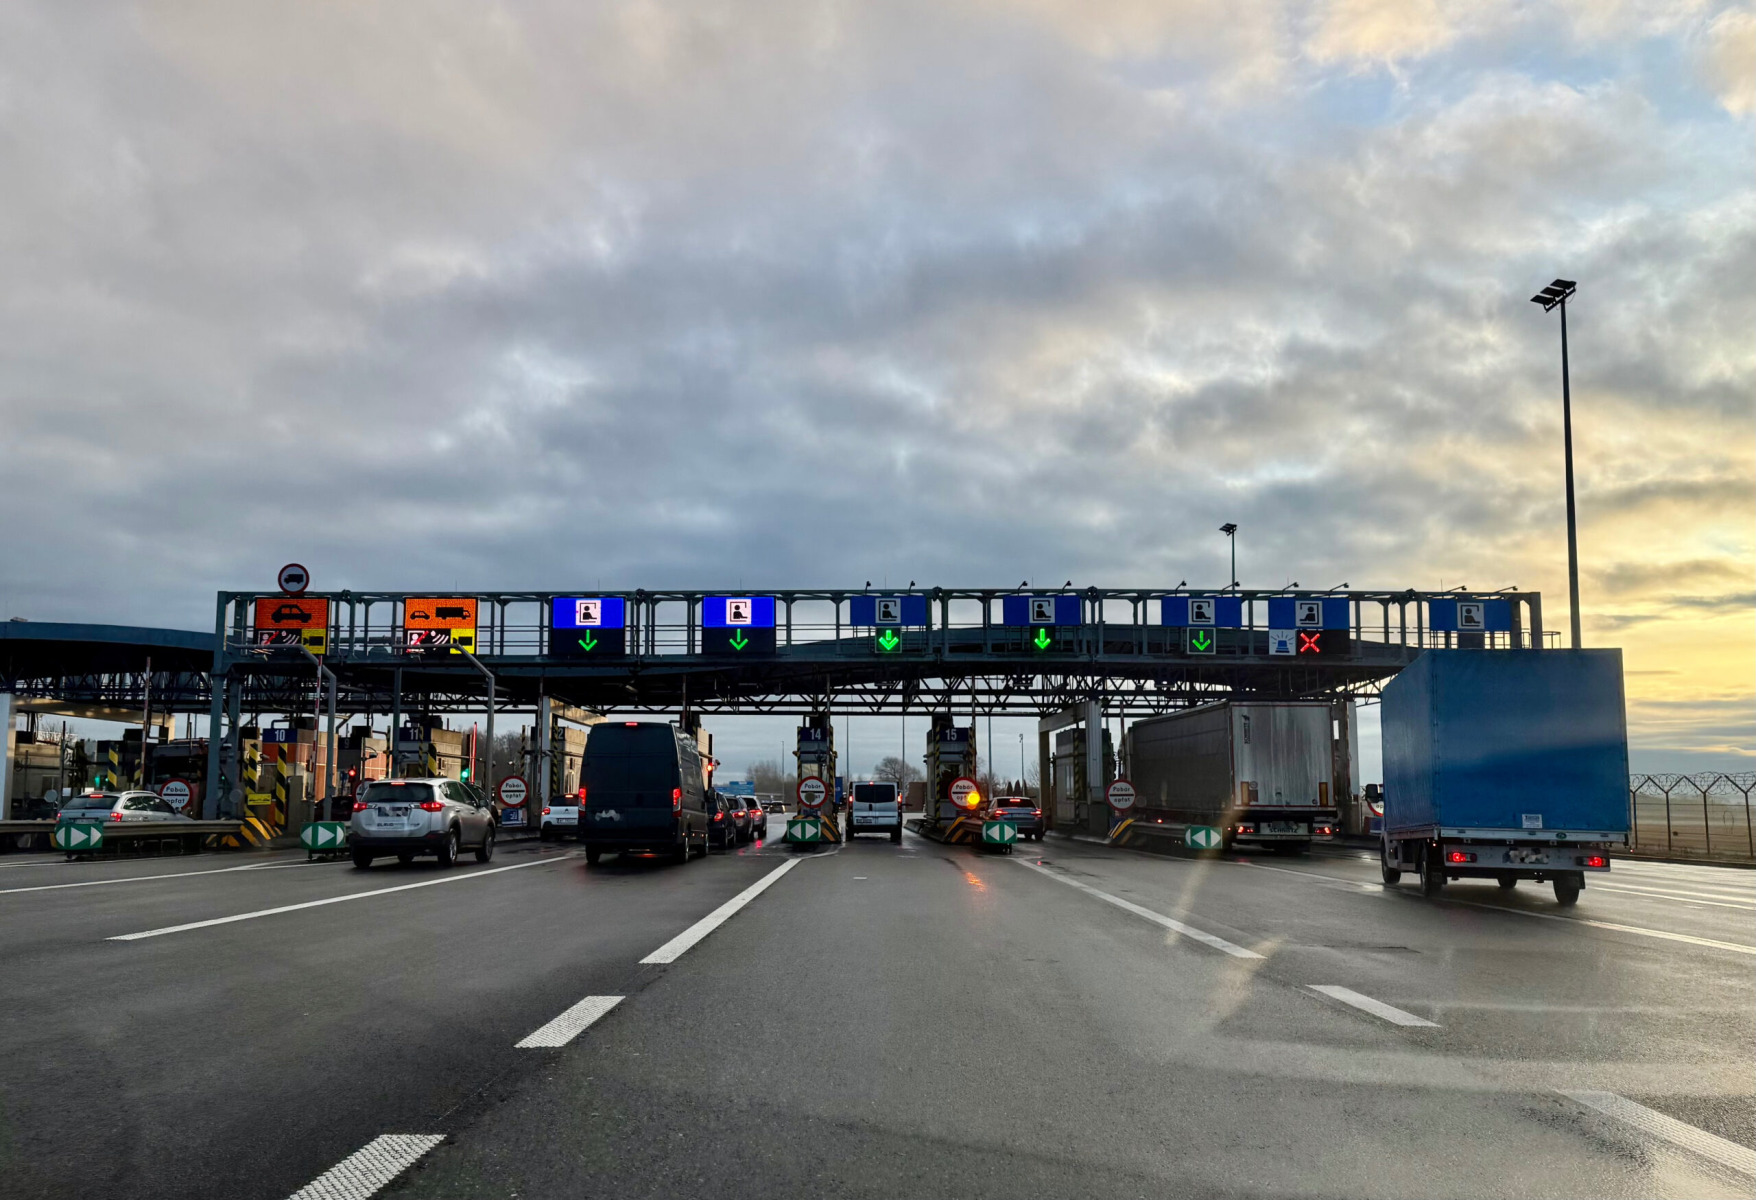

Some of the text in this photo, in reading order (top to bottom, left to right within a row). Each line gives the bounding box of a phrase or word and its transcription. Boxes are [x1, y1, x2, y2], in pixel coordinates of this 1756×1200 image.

[275, 730, 286, 741] 10
[409, 728, 419, 740] 11
[810, 728, 821, 740] 14
[945, 728, 957, 741] 15
